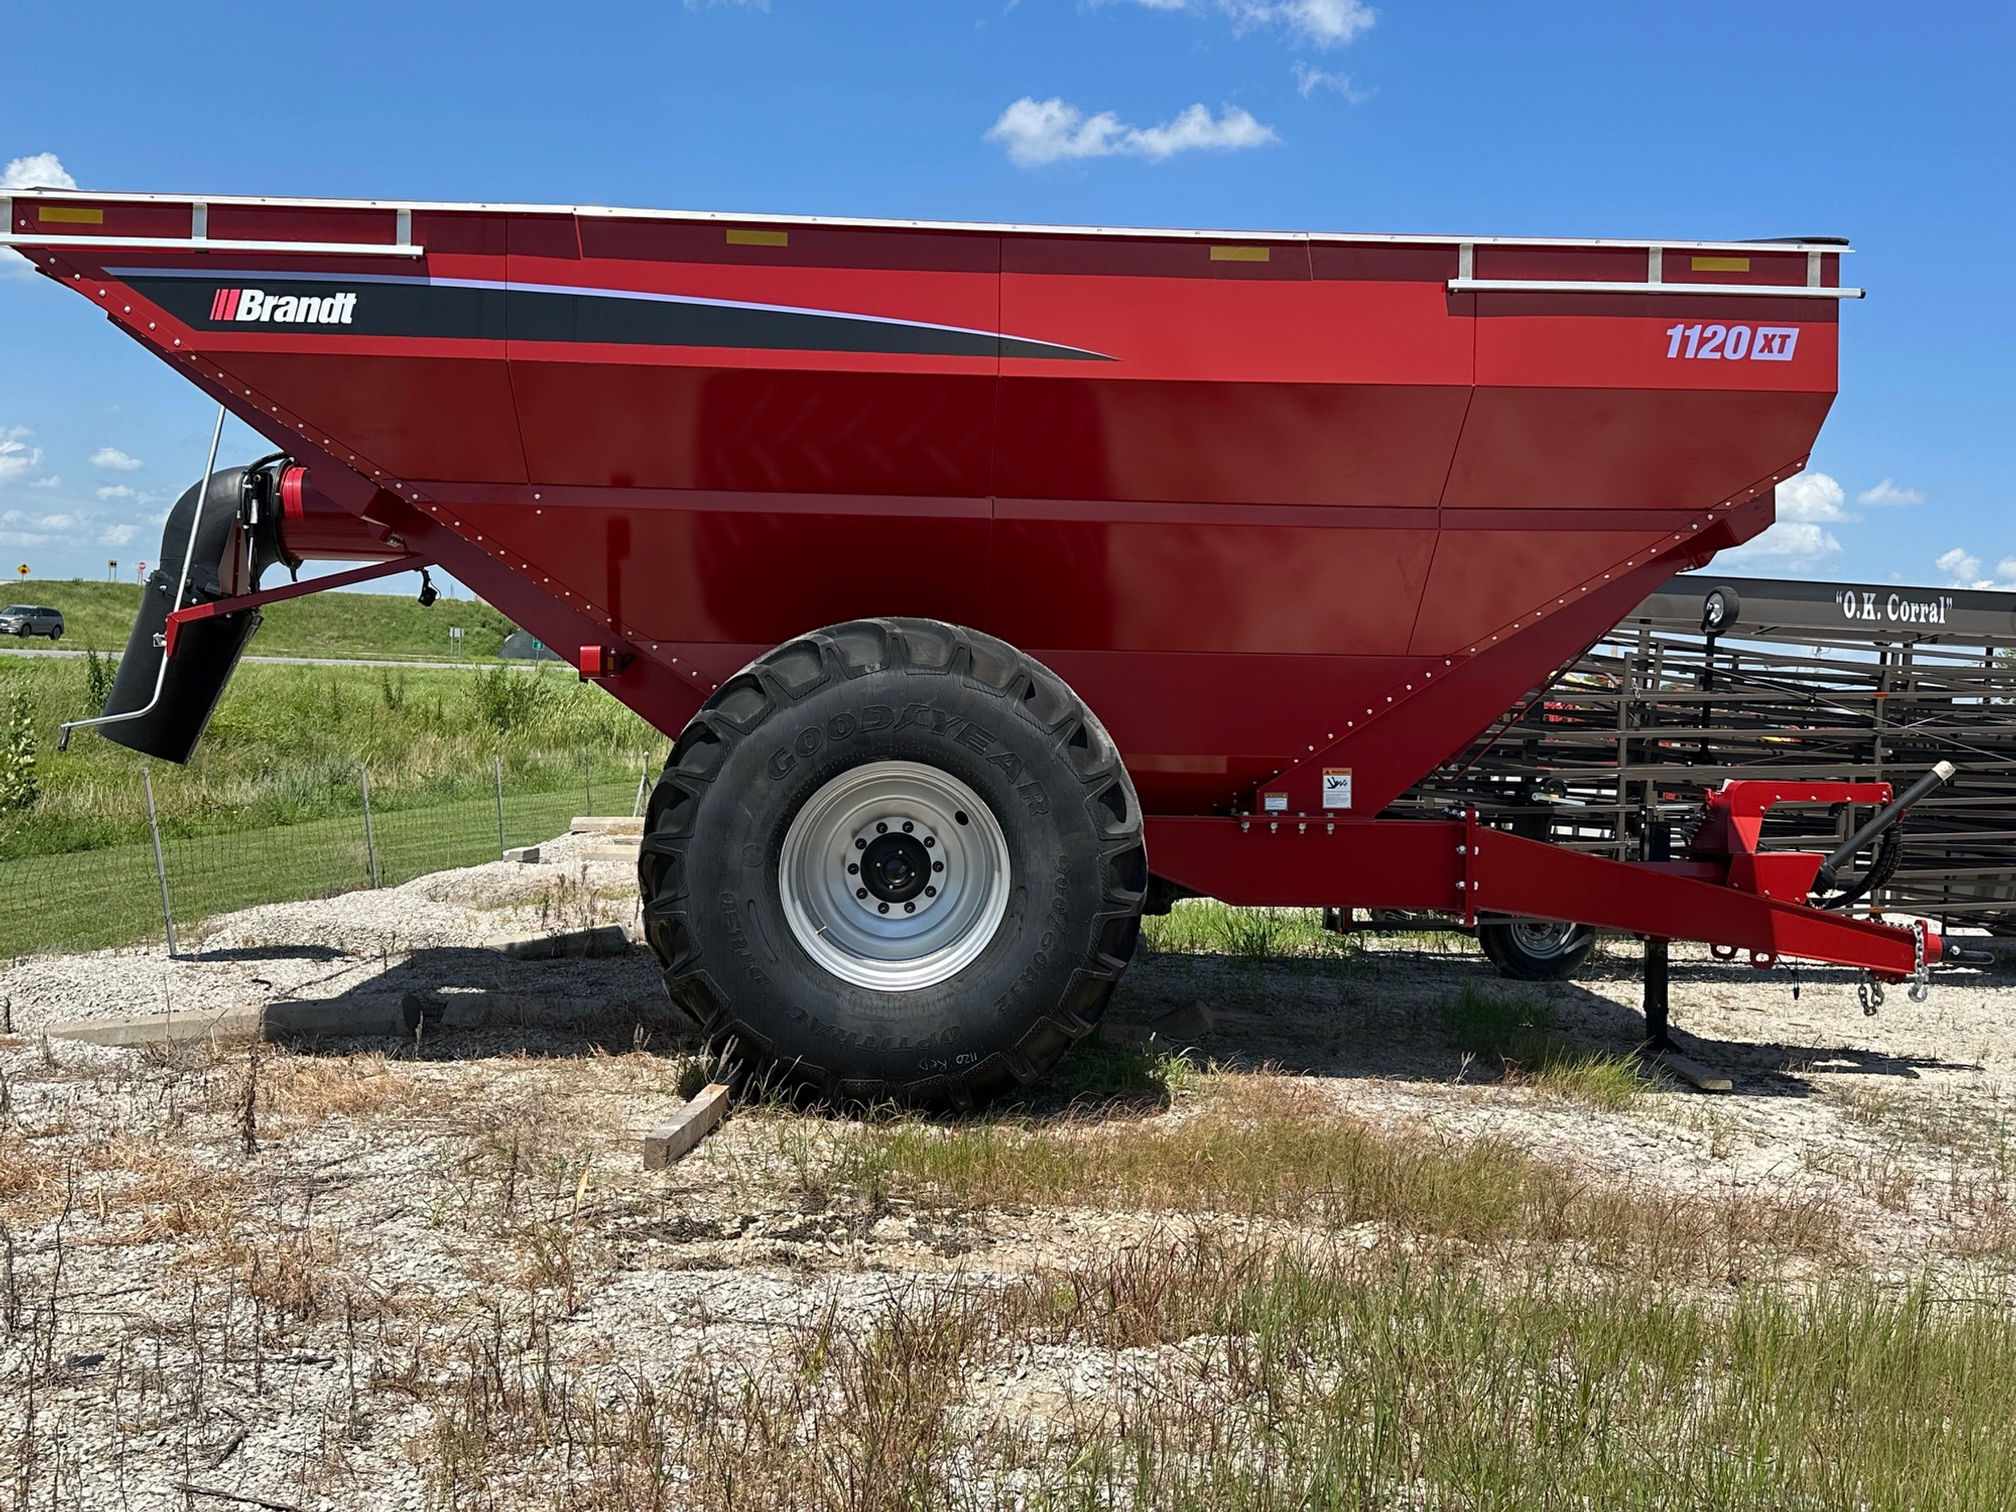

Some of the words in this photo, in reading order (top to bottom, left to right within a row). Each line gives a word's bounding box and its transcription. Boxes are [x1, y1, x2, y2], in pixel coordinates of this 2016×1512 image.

[235, 289, 357, 324] Brandt
[1666, 324, 1751, 360] 1120
[1755, 330, 1794, 356] XT
[766, 702, 1050, 817] GOODYEAR
[956, 1052, 978, 1064] 1120
